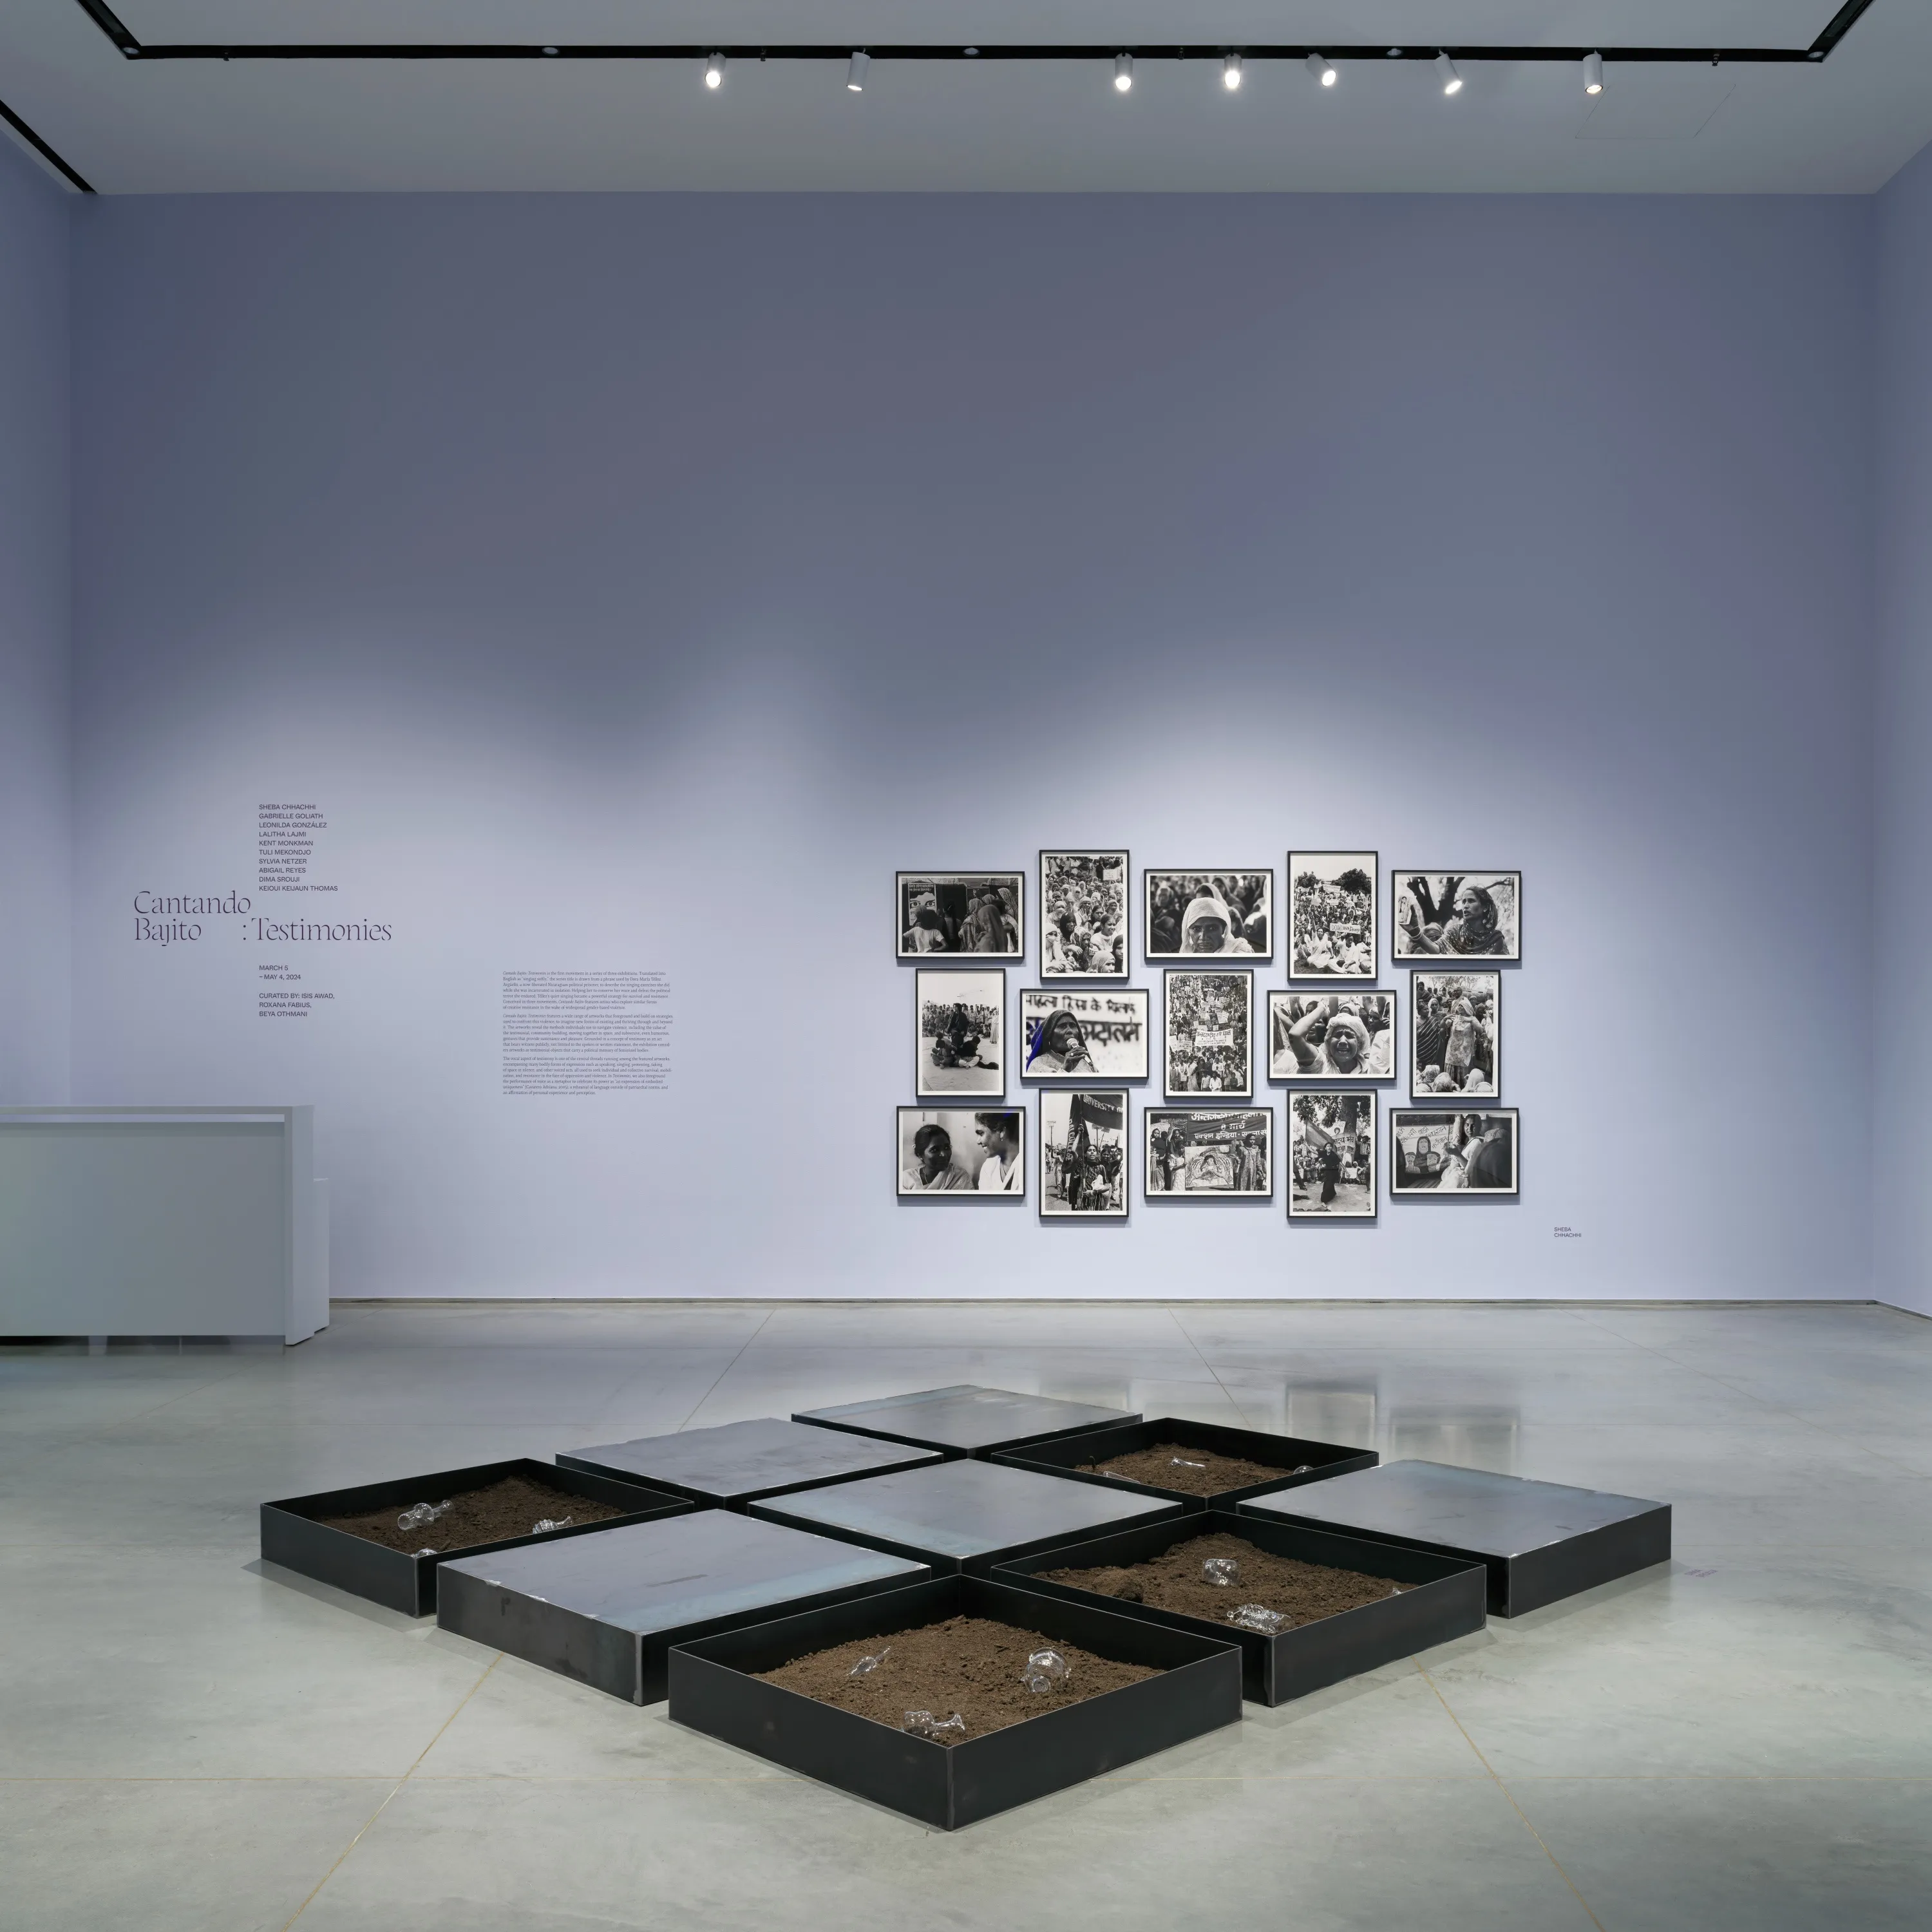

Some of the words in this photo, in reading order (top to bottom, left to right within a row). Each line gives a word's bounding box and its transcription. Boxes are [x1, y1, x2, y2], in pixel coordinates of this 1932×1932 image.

[134, 890, 251, 914] Cantando
[134, 917, 201, 946] Bajito
[1084, 1094, 1115, 1112] UNIVERSITY
